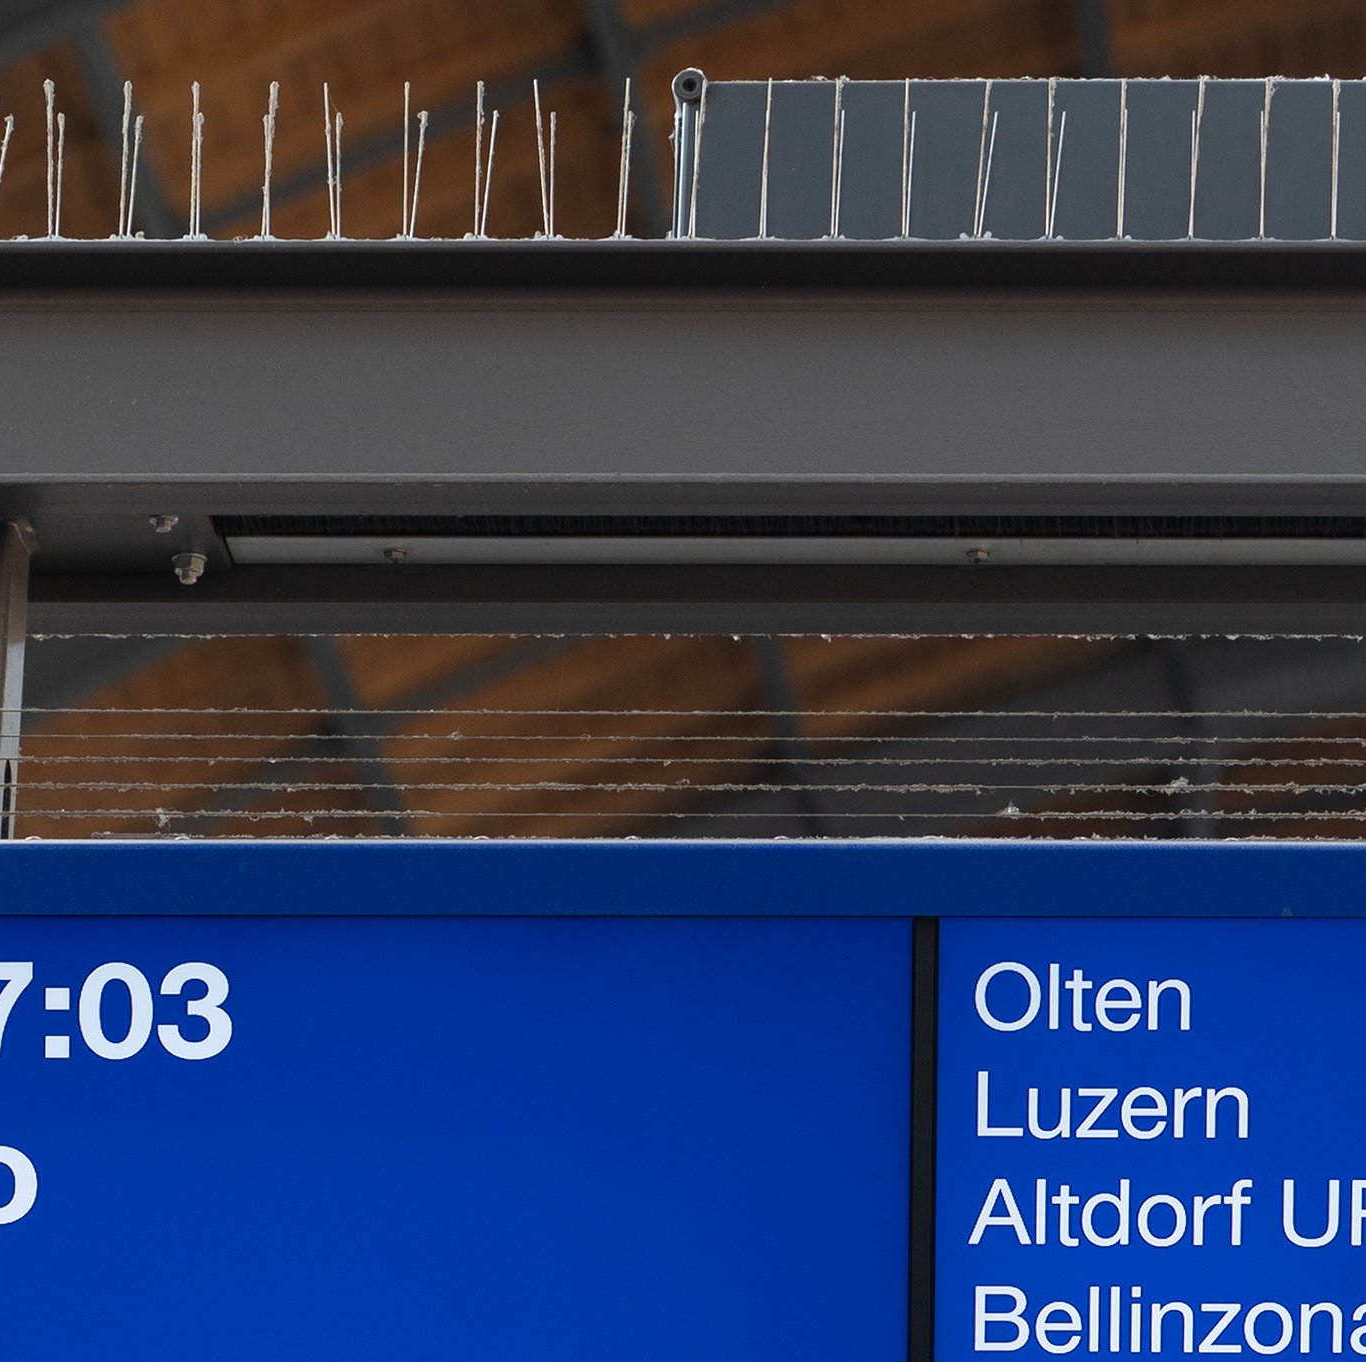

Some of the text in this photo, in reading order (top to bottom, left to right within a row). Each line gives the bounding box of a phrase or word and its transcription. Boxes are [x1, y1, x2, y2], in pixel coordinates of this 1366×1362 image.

[974, 961, 1191, 1032] Olten
[977, 1070, 1249, 1140] Luzern
[968, 1178, 1253, 1247] Altdorf
